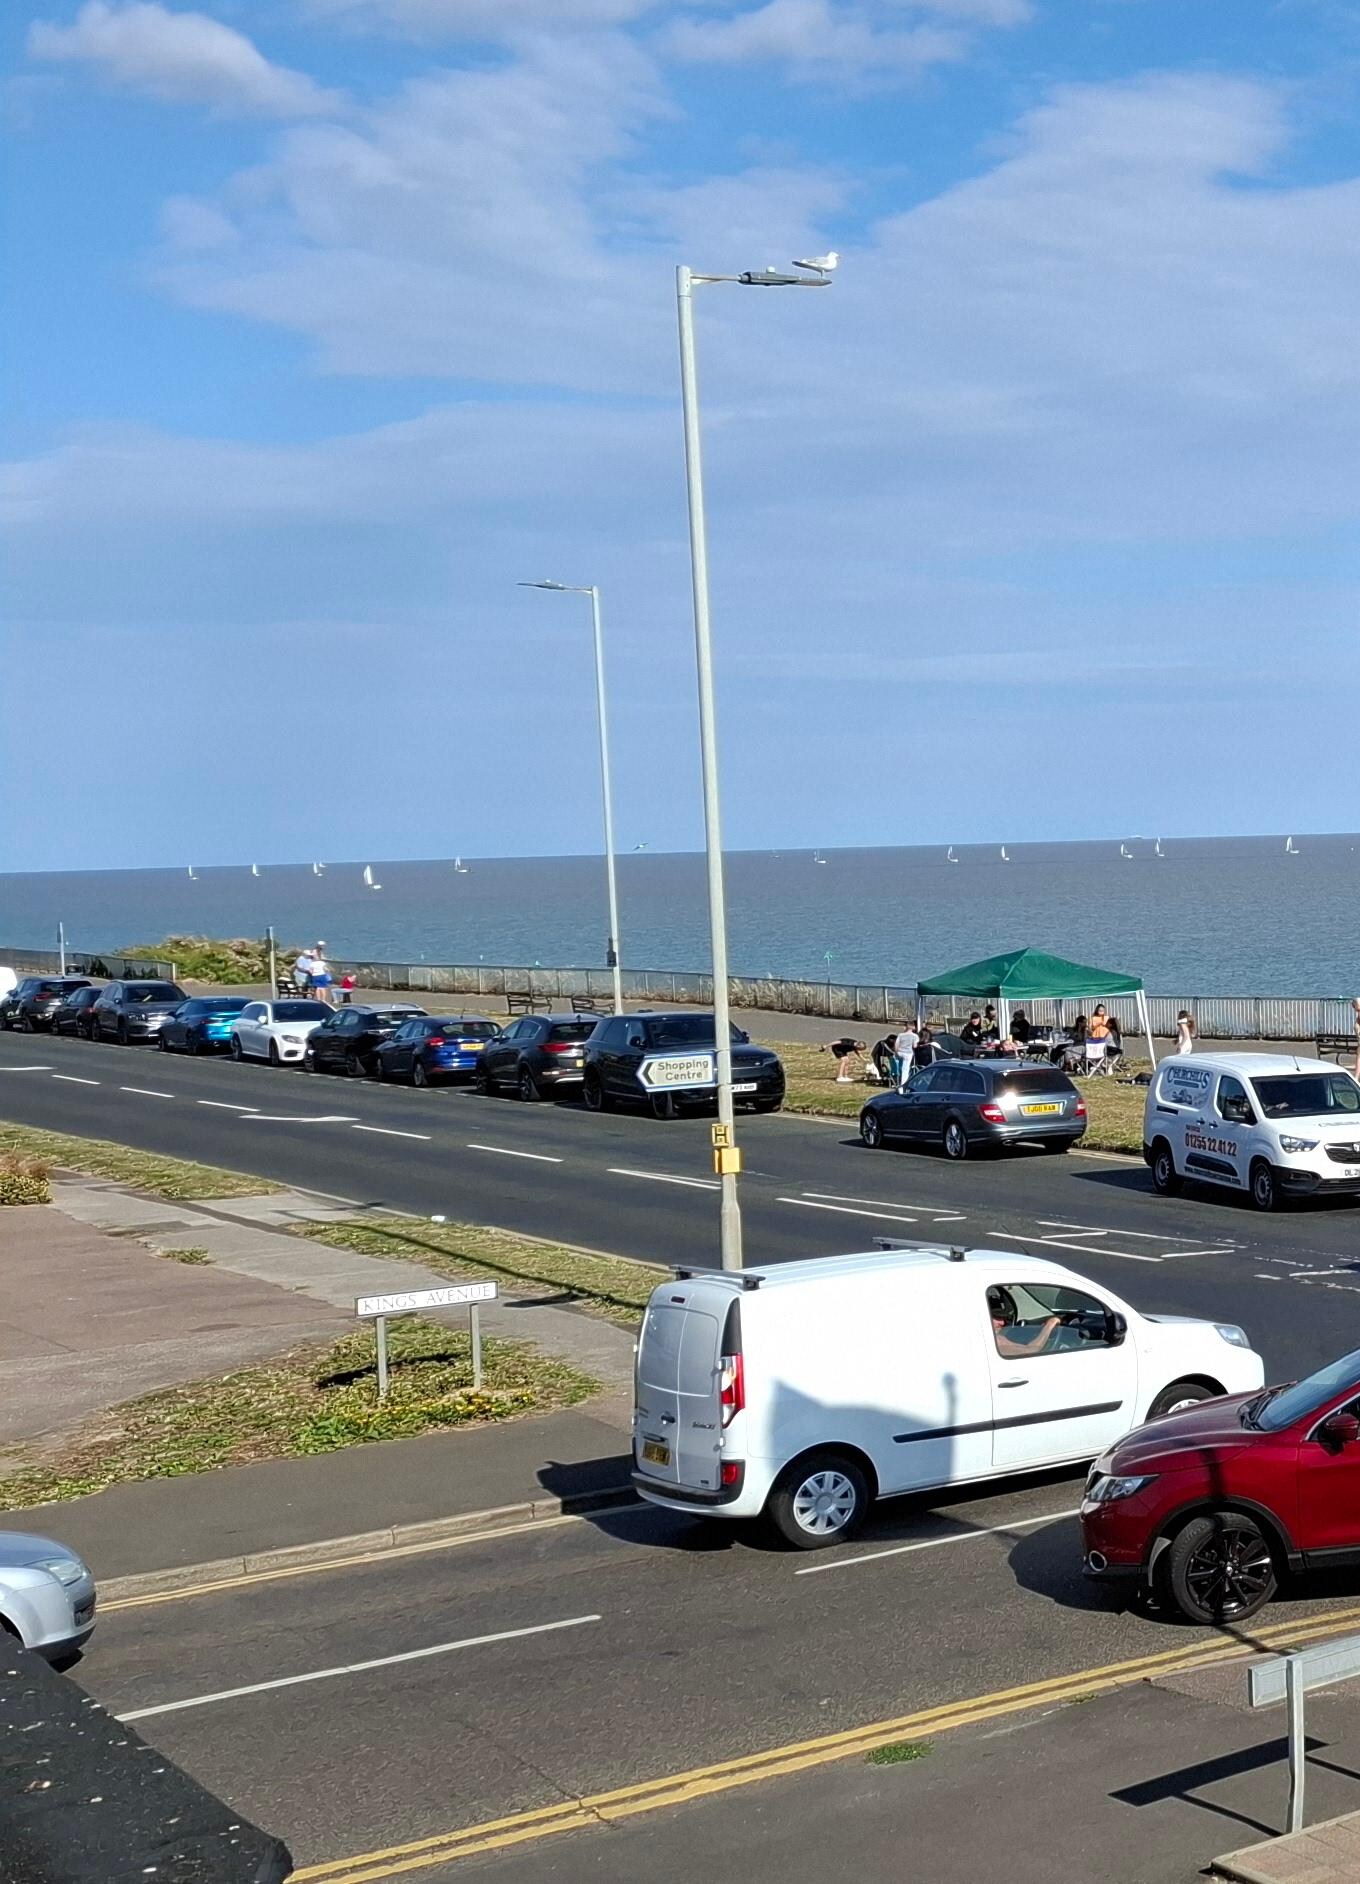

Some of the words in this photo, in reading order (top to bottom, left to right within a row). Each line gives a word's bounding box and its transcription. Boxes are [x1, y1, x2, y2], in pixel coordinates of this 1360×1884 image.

[657, 1059, 709, 1071] Shopping
[665, 1071, 702, 1081] Centre
[714, 1125, 728, 1144] H
[363, 1294, 417, 1312] KINGS
[427, 1285, 491, 1305] AVENUE
